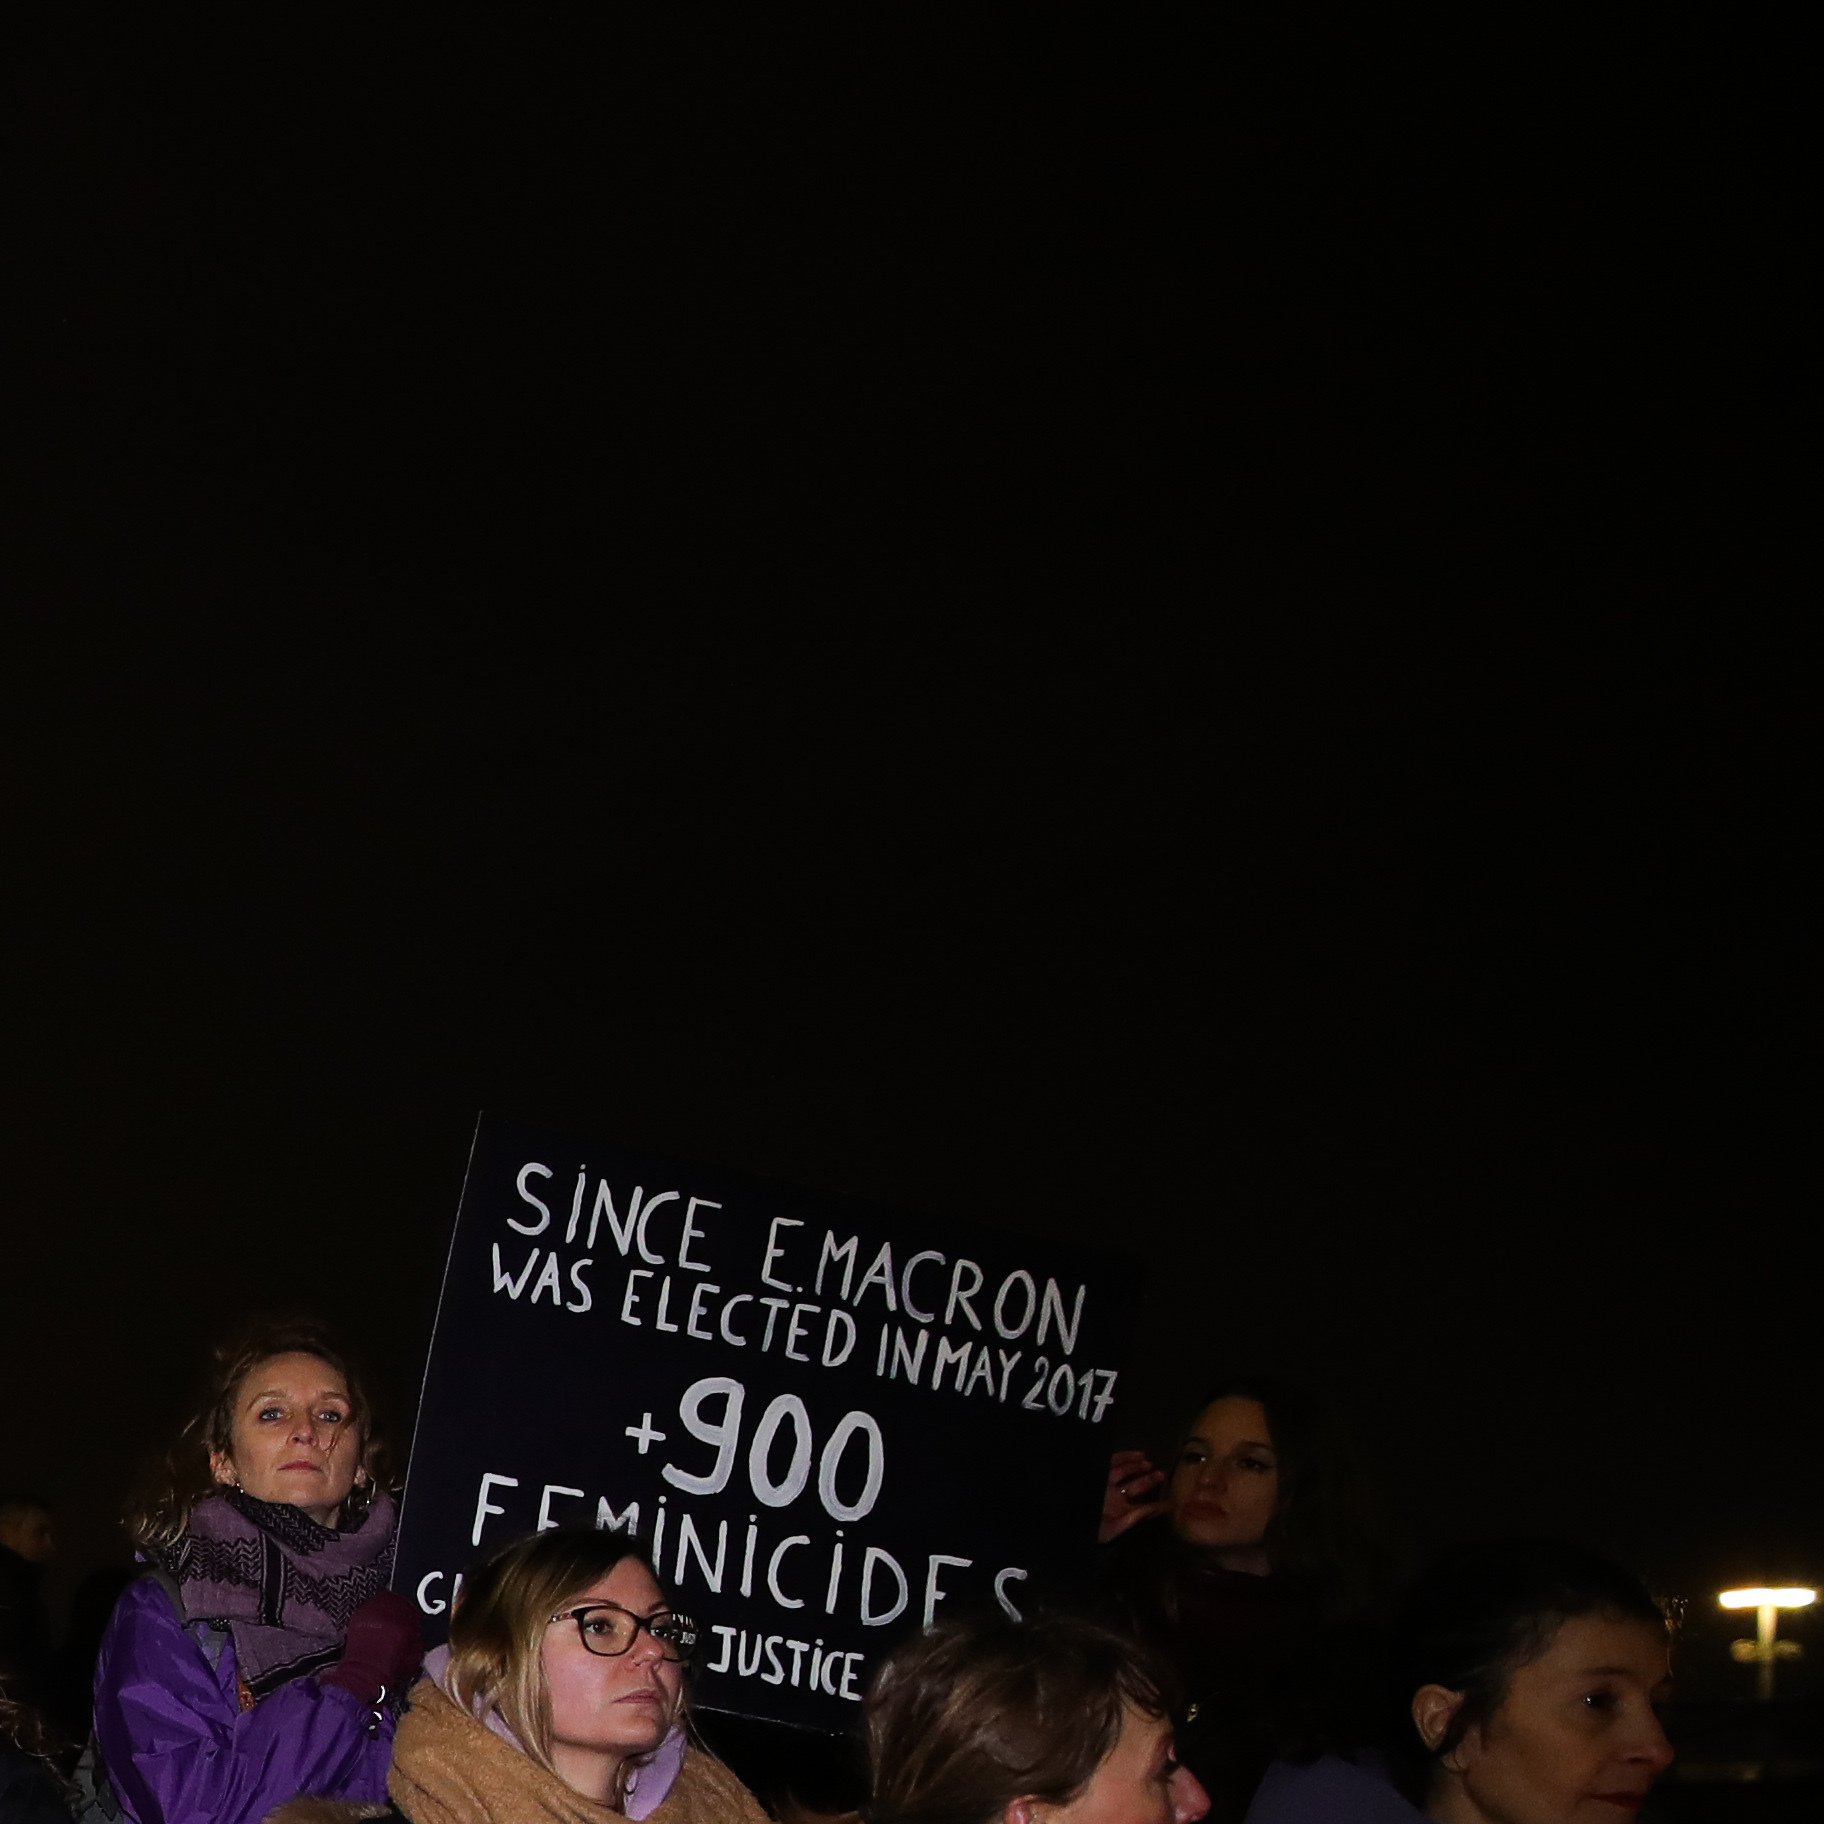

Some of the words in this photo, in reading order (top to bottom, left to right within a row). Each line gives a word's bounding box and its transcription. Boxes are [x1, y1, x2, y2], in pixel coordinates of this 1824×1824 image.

[507, 1163, 722, 1272] SINCE
[493, 1243, 593, 1312] WAS
[621, 1270, 856, 1367] ELECTED
[1022, 1356, 1118, 1422] 2017
[625, 1377, 884, 1522] +900
[707, 1625, 864, 1701] JUSTICE
